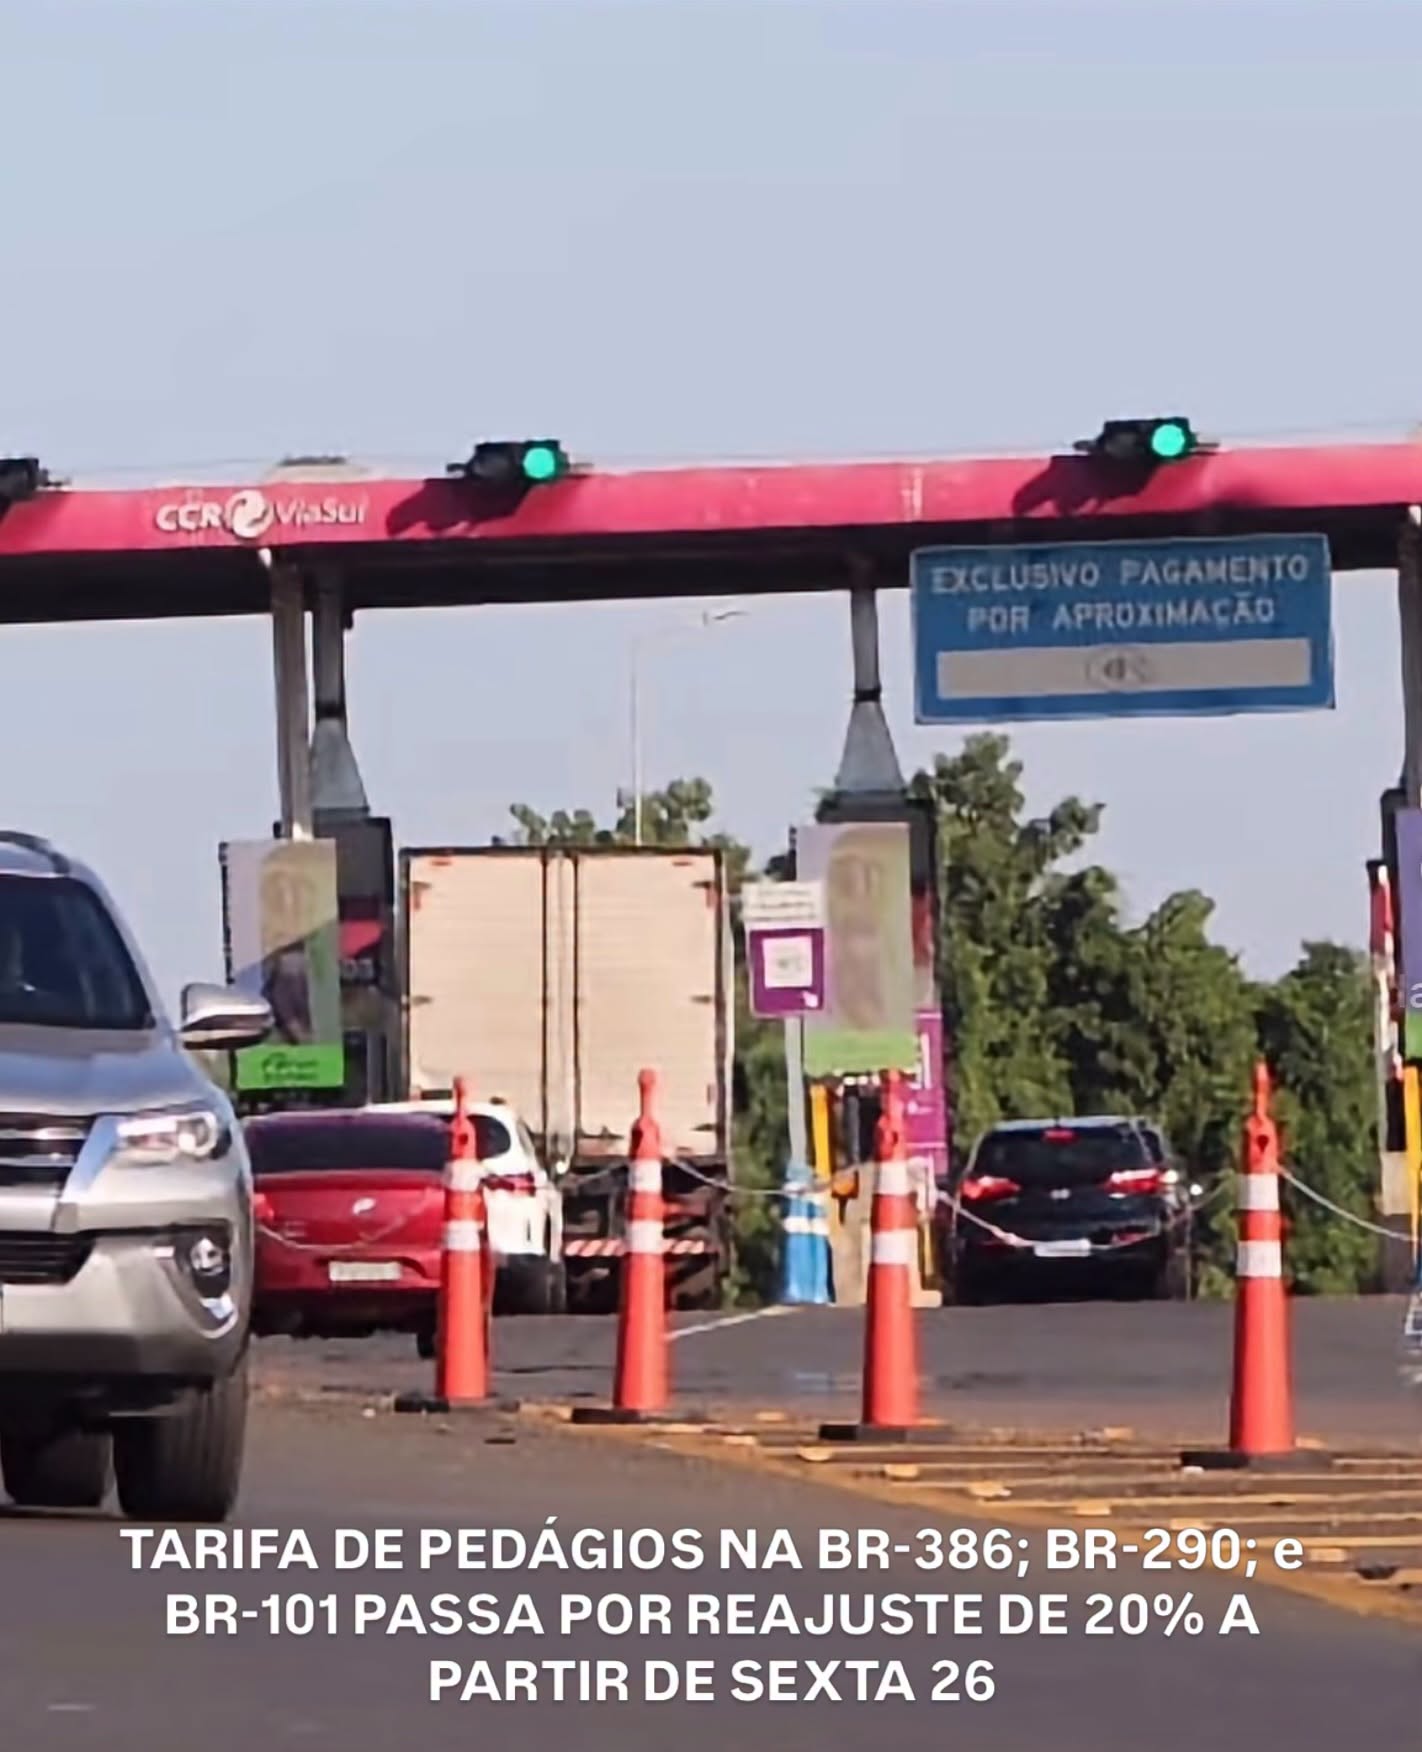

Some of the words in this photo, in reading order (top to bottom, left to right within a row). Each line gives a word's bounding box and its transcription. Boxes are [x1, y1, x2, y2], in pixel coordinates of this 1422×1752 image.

[156, 502, 224, 532] CCR
[931, 562, 1100, 594] EXCLUSIVO
[1120, 555, 1309, 587] PAGAMENTO
[968, 606, 1030, 632] POR
[1052, 592, 1275, 630] APROXIMAÇÃO
